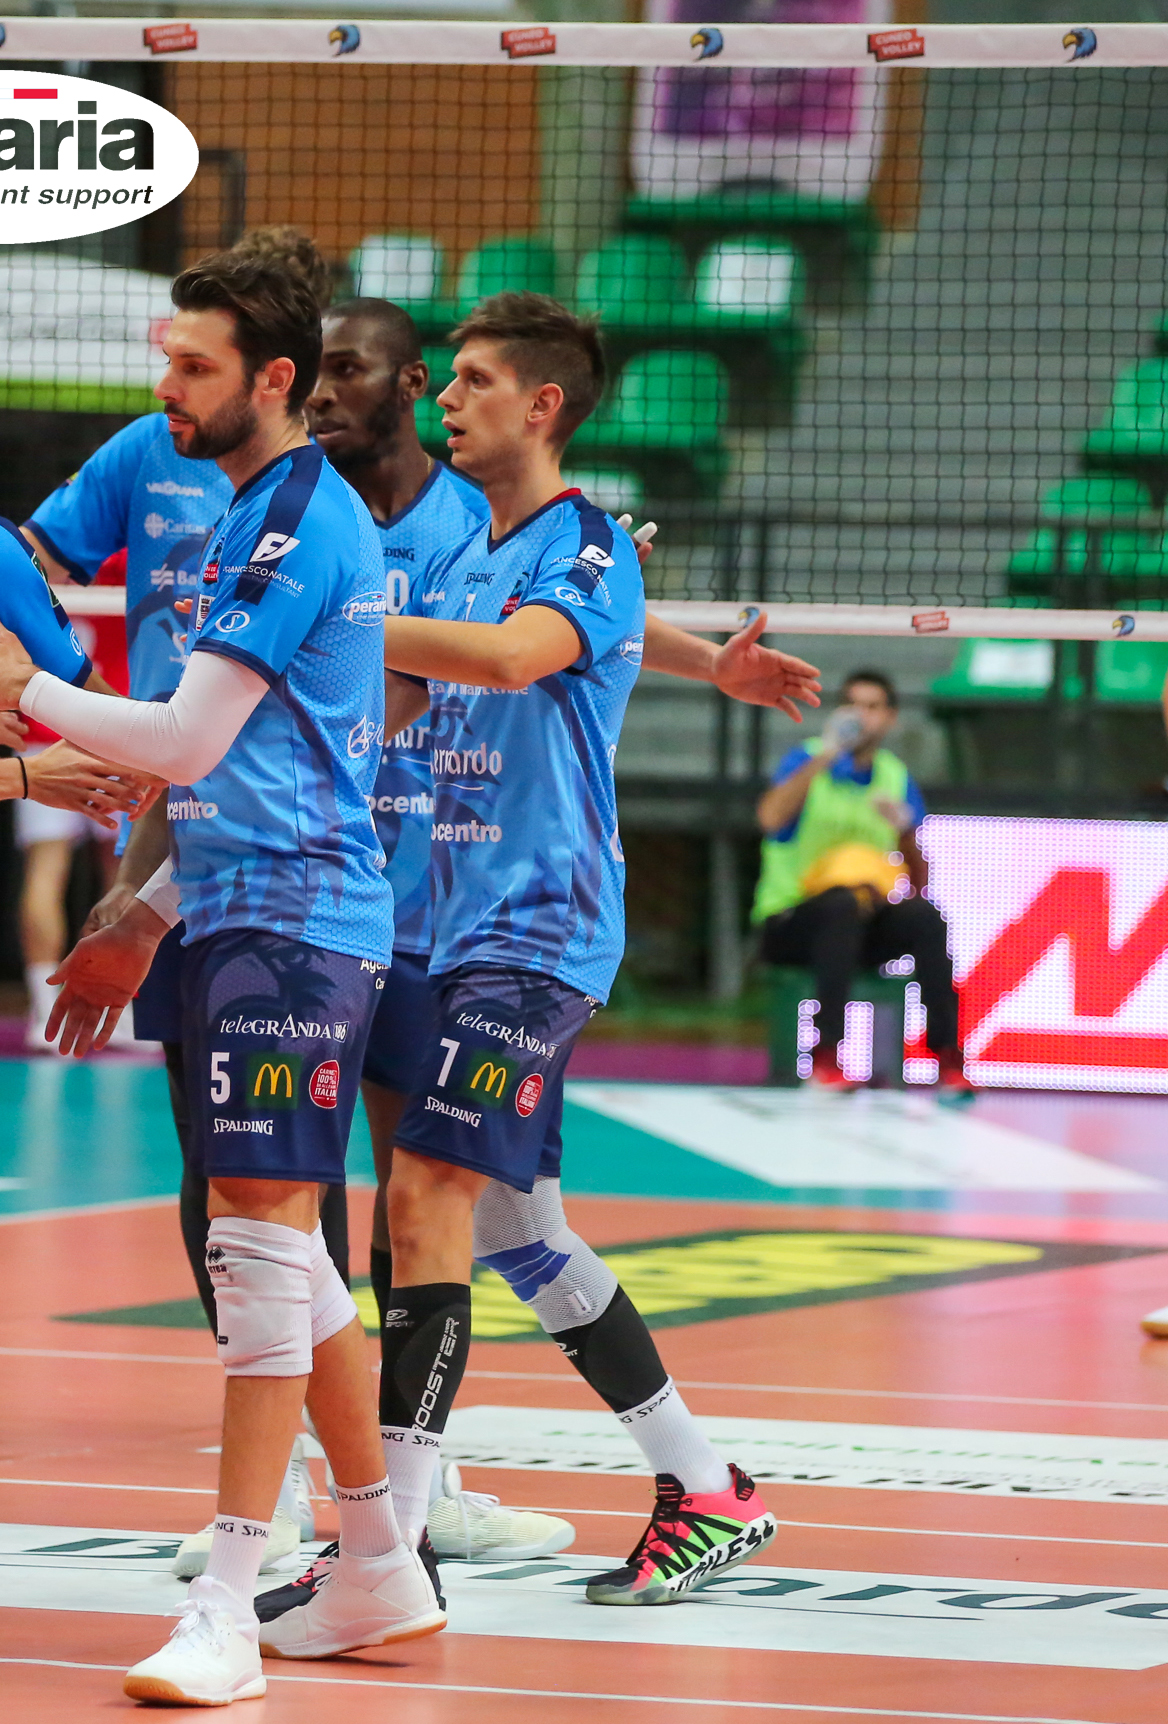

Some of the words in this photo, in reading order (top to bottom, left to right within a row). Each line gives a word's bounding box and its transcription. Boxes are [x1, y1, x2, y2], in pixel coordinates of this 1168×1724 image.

[383, 547, 415, 562] DING
[268, 570, 305, 593] NATALE
[431, 742, 503, 776] ernardo
[220, 1013, 331, 1040] teleGRANDA
[334, 1023, 347, 1041] 186
[456, 1011, 546, 1057] teleGRANDA
[210, 1051, 231, 1104] 5
[314, 1088, 337, 1098] ITALIA
[424, 1095, 482, 1128] SPALDING
[213, 1118, 274, 1136] SPALDING
